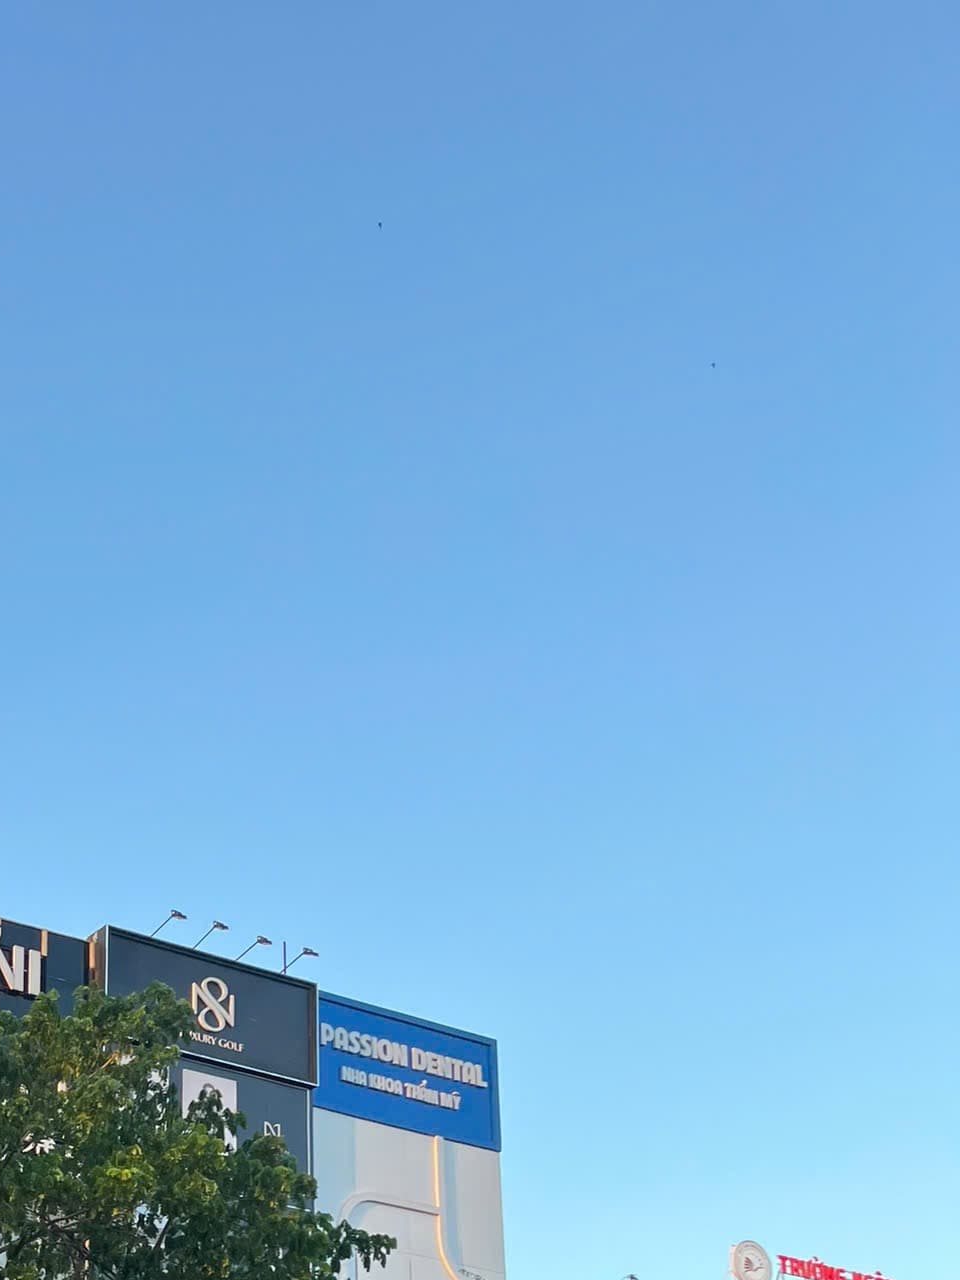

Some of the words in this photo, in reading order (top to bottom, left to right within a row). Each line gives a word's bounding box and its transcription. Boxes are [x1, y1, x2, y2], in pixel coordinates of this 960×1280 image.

[218, 1038, 245, 1053] GOLF
[320, 1022, 408, 1068] PASSION
[411, 1046, 488, 1089] DENTAL
[341, 1065, 367, 1087] NHA
[368, 1073, 403, 1096] KHOA
